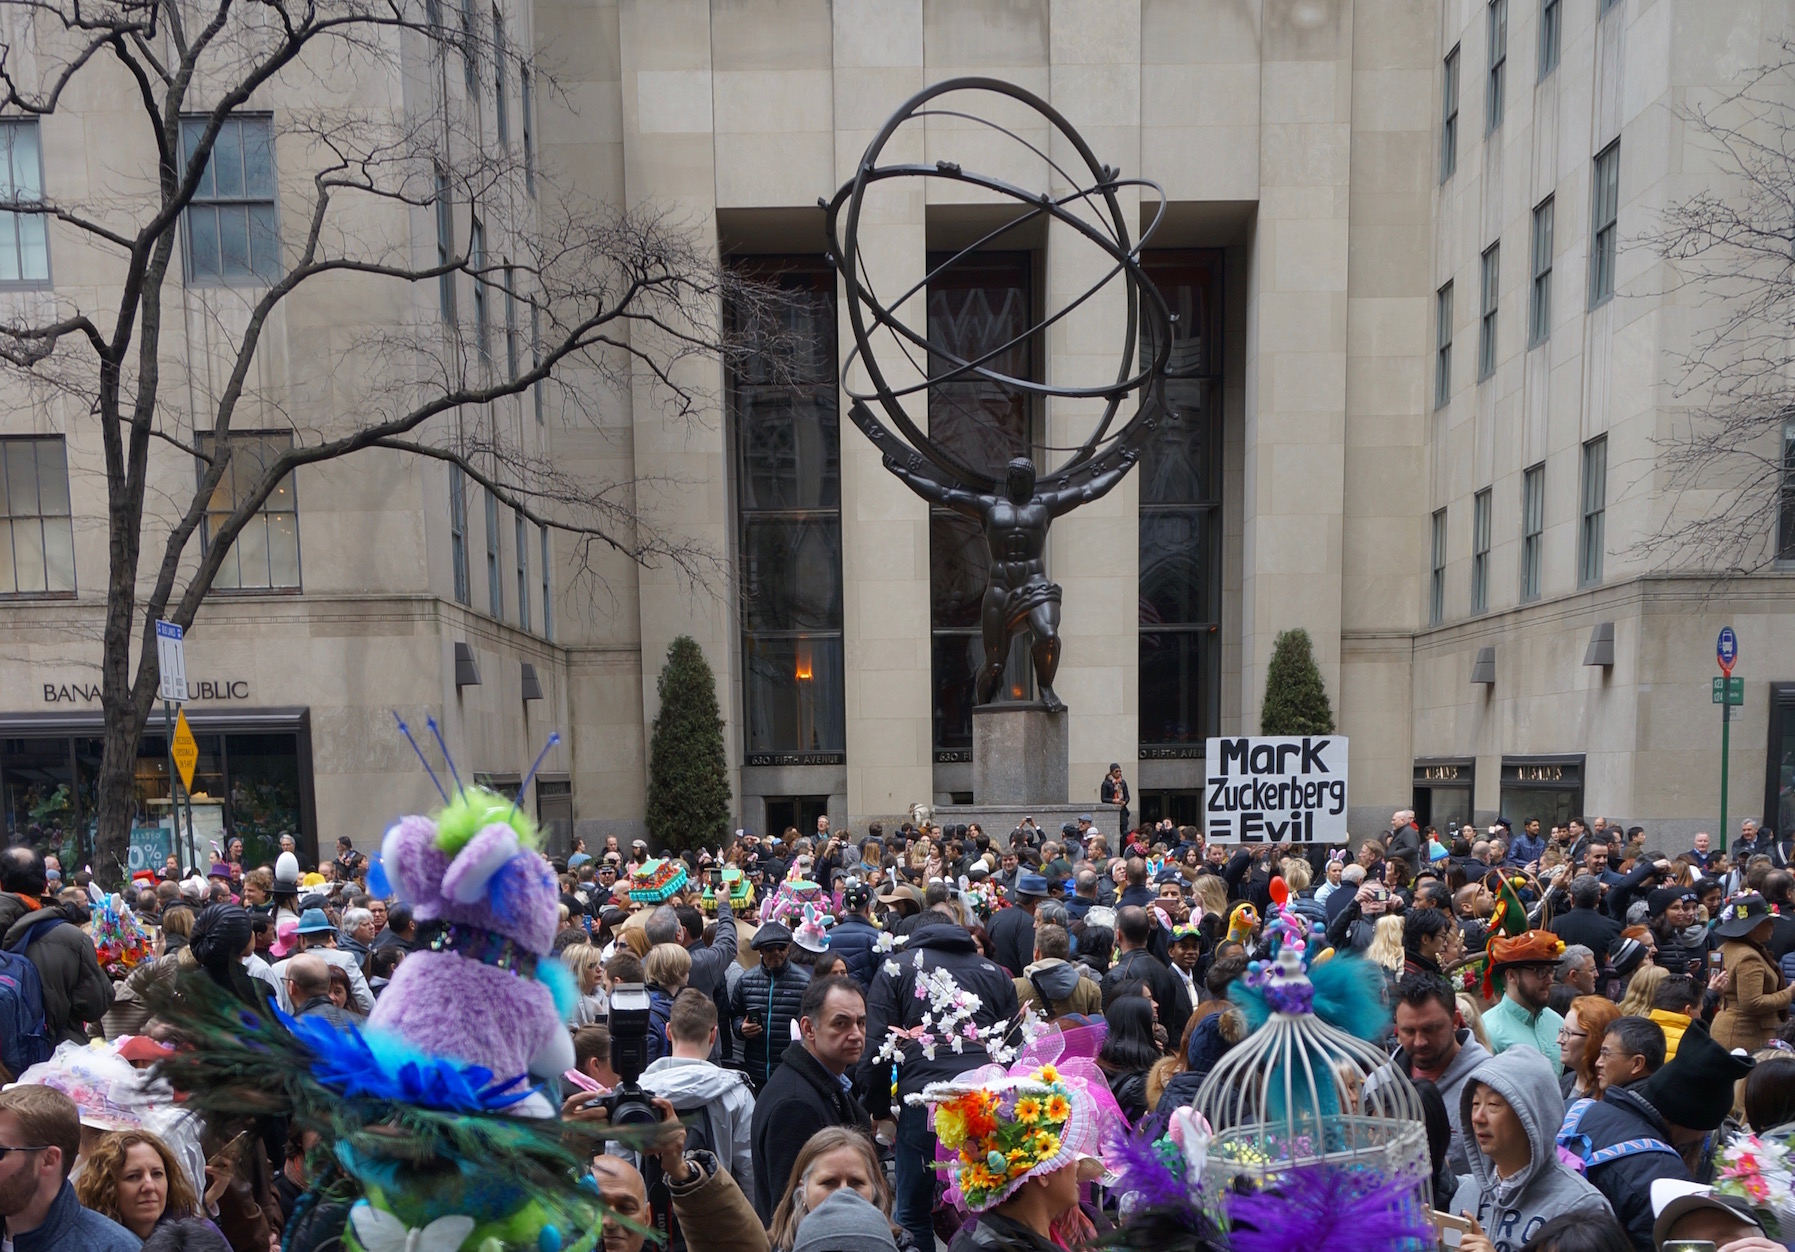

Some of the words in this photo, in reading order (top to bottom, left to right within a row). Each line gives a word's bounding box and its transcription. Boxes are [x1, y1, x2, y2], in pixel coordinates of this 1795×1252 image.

[43, 683, 131, 702] BANA
[155, 681, 248, 699] UBLIC
[752, 755, 771, 765] 630
[774, 755, 799, 765] FIFTH
[803, 754, 839, 764] AVENUE
[939, 752, 958, 761] 630
[1152, 749, 1177, 758] FIFTH
[1181, 748, 1204, 758] AVEN
[1208, 776, 1345, 815] Zuckerberg
[1240, 811, 1313, 842] Evil
[129, 843, 162, 870] 0%
[1477, 1203, 1546, 1244] ERO
